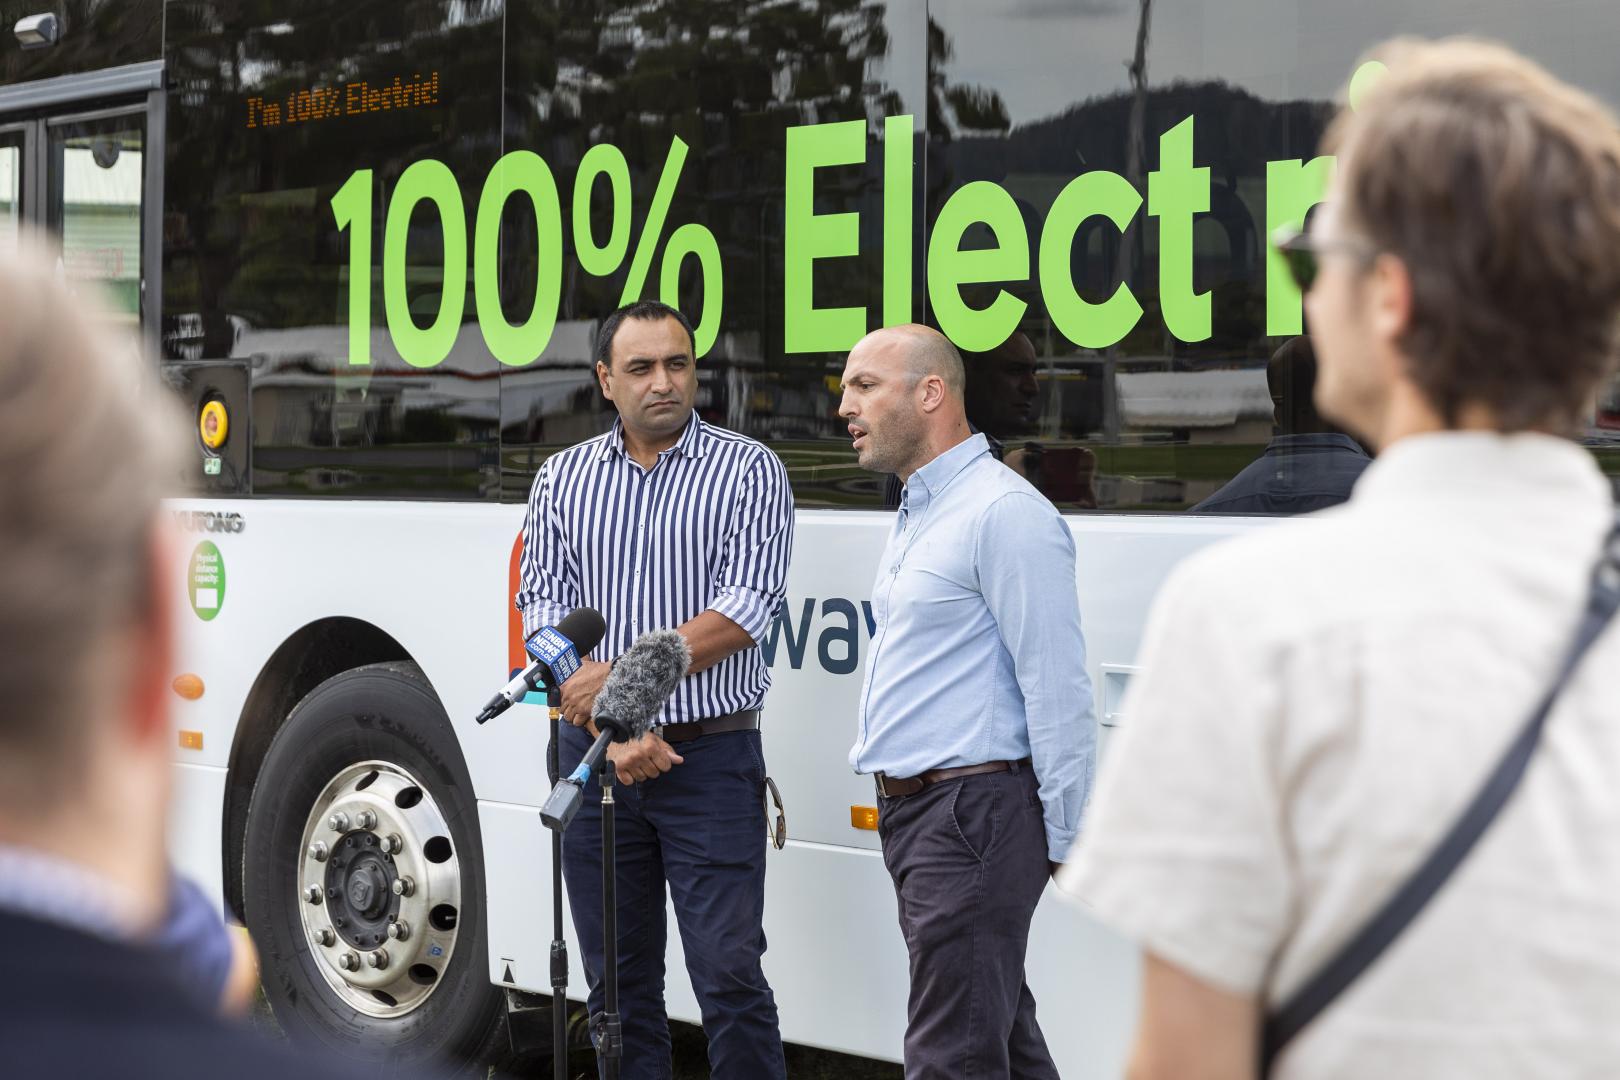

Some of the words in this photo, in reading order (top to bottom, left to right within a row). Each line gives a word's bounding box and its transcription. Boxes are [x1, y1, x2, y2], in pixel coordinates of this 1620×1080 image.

[247, 98, 280, 127] I'm
[287, 88, 340, 122] 100%
[346, 72, 438, 114] Electric!
[331, 135, 723, 369] 100%
[785, 62, 1388, 353] Electr
[533, 635, 560, 657] NEWS
[548, 631, 568, 650] NBN
[529, 643, 554, 661] .com.au
